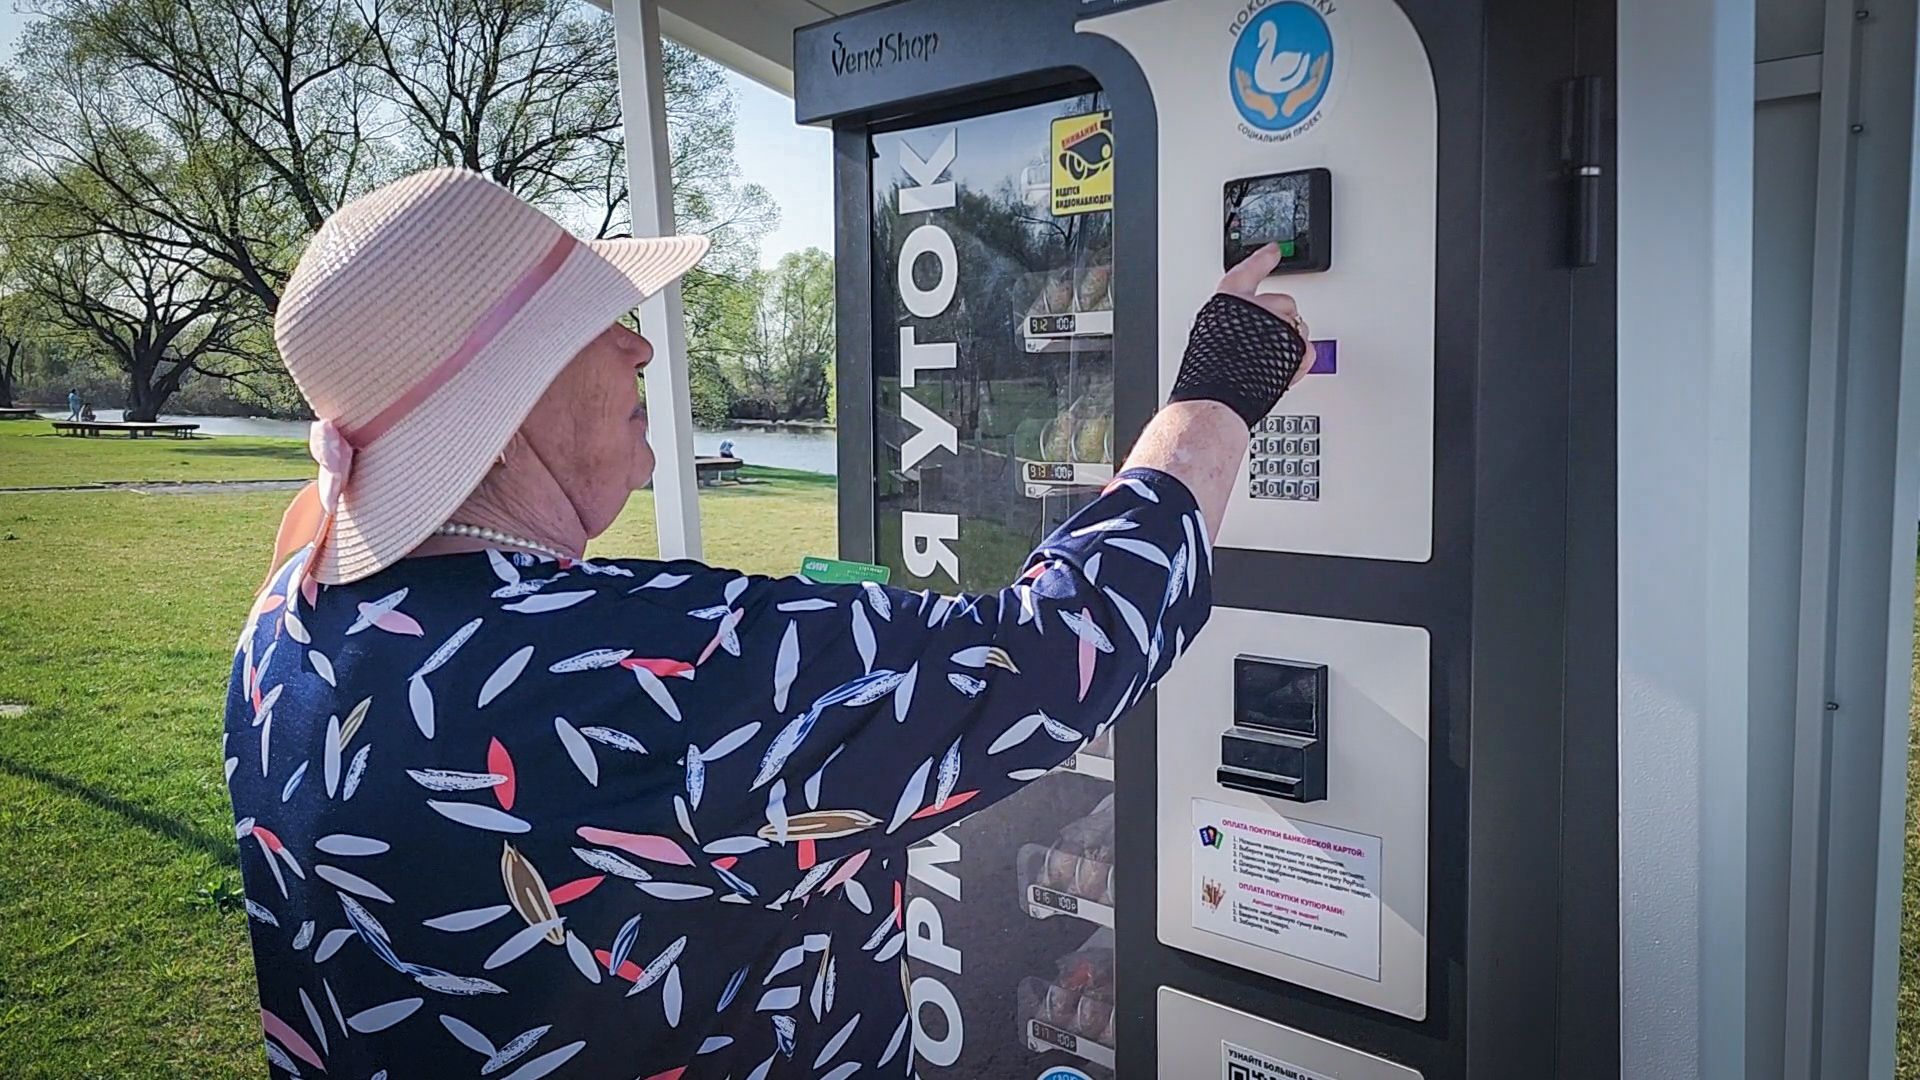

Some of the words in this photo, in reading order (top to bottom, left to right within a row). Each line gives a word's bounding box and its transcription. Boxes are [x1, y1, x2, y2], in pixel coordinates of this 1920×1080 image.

[1237, 121, 1292, 143] СОЦИАЛЬНЫЙ
[1293, 109, 1323, 136] ПРОЕКТ
[1061, 121, 1099, 148] ВНИМАНИЕ
[1055, 185, 1080, 198] ВЕДЕТСЯ
[1055, 194, 1111, 209] ВИДЕОНАБЛЮДЕН
[899, 127, 959, 474] УТОК
[1031, 318, 1048, 332] 912
[1268, 421, 1275, 431] 2
[1286, 421, 1293, 431] 3
[1303, 421, 1310, 430] A
[1268, 442, 1275, 451] 5
[1286, 442, 1292, 451] 6
[1303, 442, 1310, 452] B
[1030, 465, 1046, 478] 913
[1268, 463, 1275, 472] 8
[1286, 463, 1292, 473] 9
[1303, 464, 1310, 473] C
[1303, 484, 1310, 494] D
[1222, 819, 1247, 830] ОПЛАТА
[1249, 825, 1281, 838] ПОКУПКИ
[1283, 831, 1331, 850] БАНКОВСКОЙ
[1333, 842, 1364, 857] КАРТОЙ:
[1238, 881, 1264, 894] ОПЛАТА
[1266, 889, 1298, 903] ПОКУПКИ
[1300, 898, 1344, 916] КУПЮРАМИ:
[906, 821, 964, 1080] ОРМ
[1228, 1049, 1262, 1067] УЗНАЙТЕ
[1264, 1061, 1298, 1080] БОЛЬШЕ
